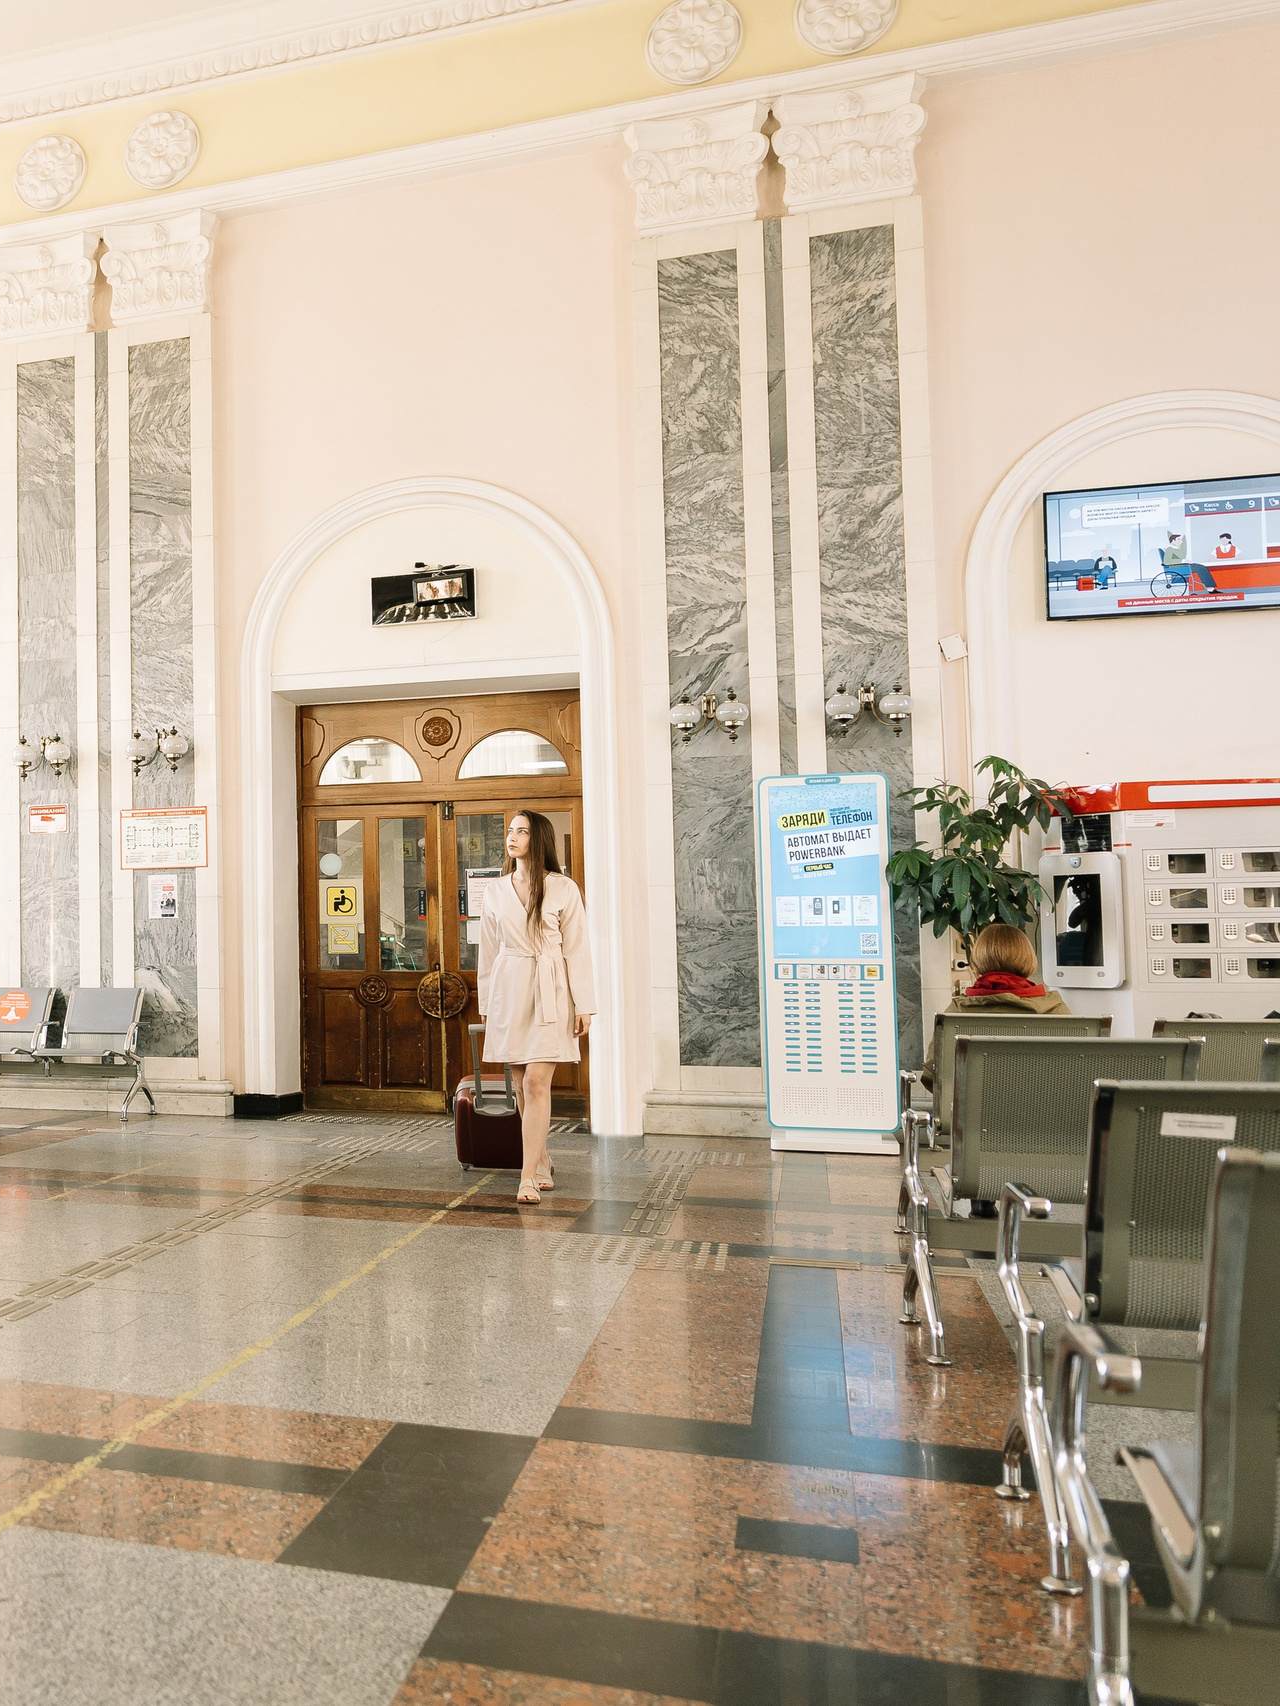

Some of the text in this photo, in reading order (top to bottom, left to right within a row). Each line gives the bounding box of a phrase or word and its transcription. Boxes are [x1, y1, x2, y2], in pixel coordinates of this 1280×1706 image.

[1248, 500, 1255, 508] 9
[781, 811, 873, 829] ЗАРЯДИ ТЕЛЕФОН
[787, 828, 872, 849] АВТОМАТ ВЫДАЕТ
[789, 845, 846, 861] POWERBANK
